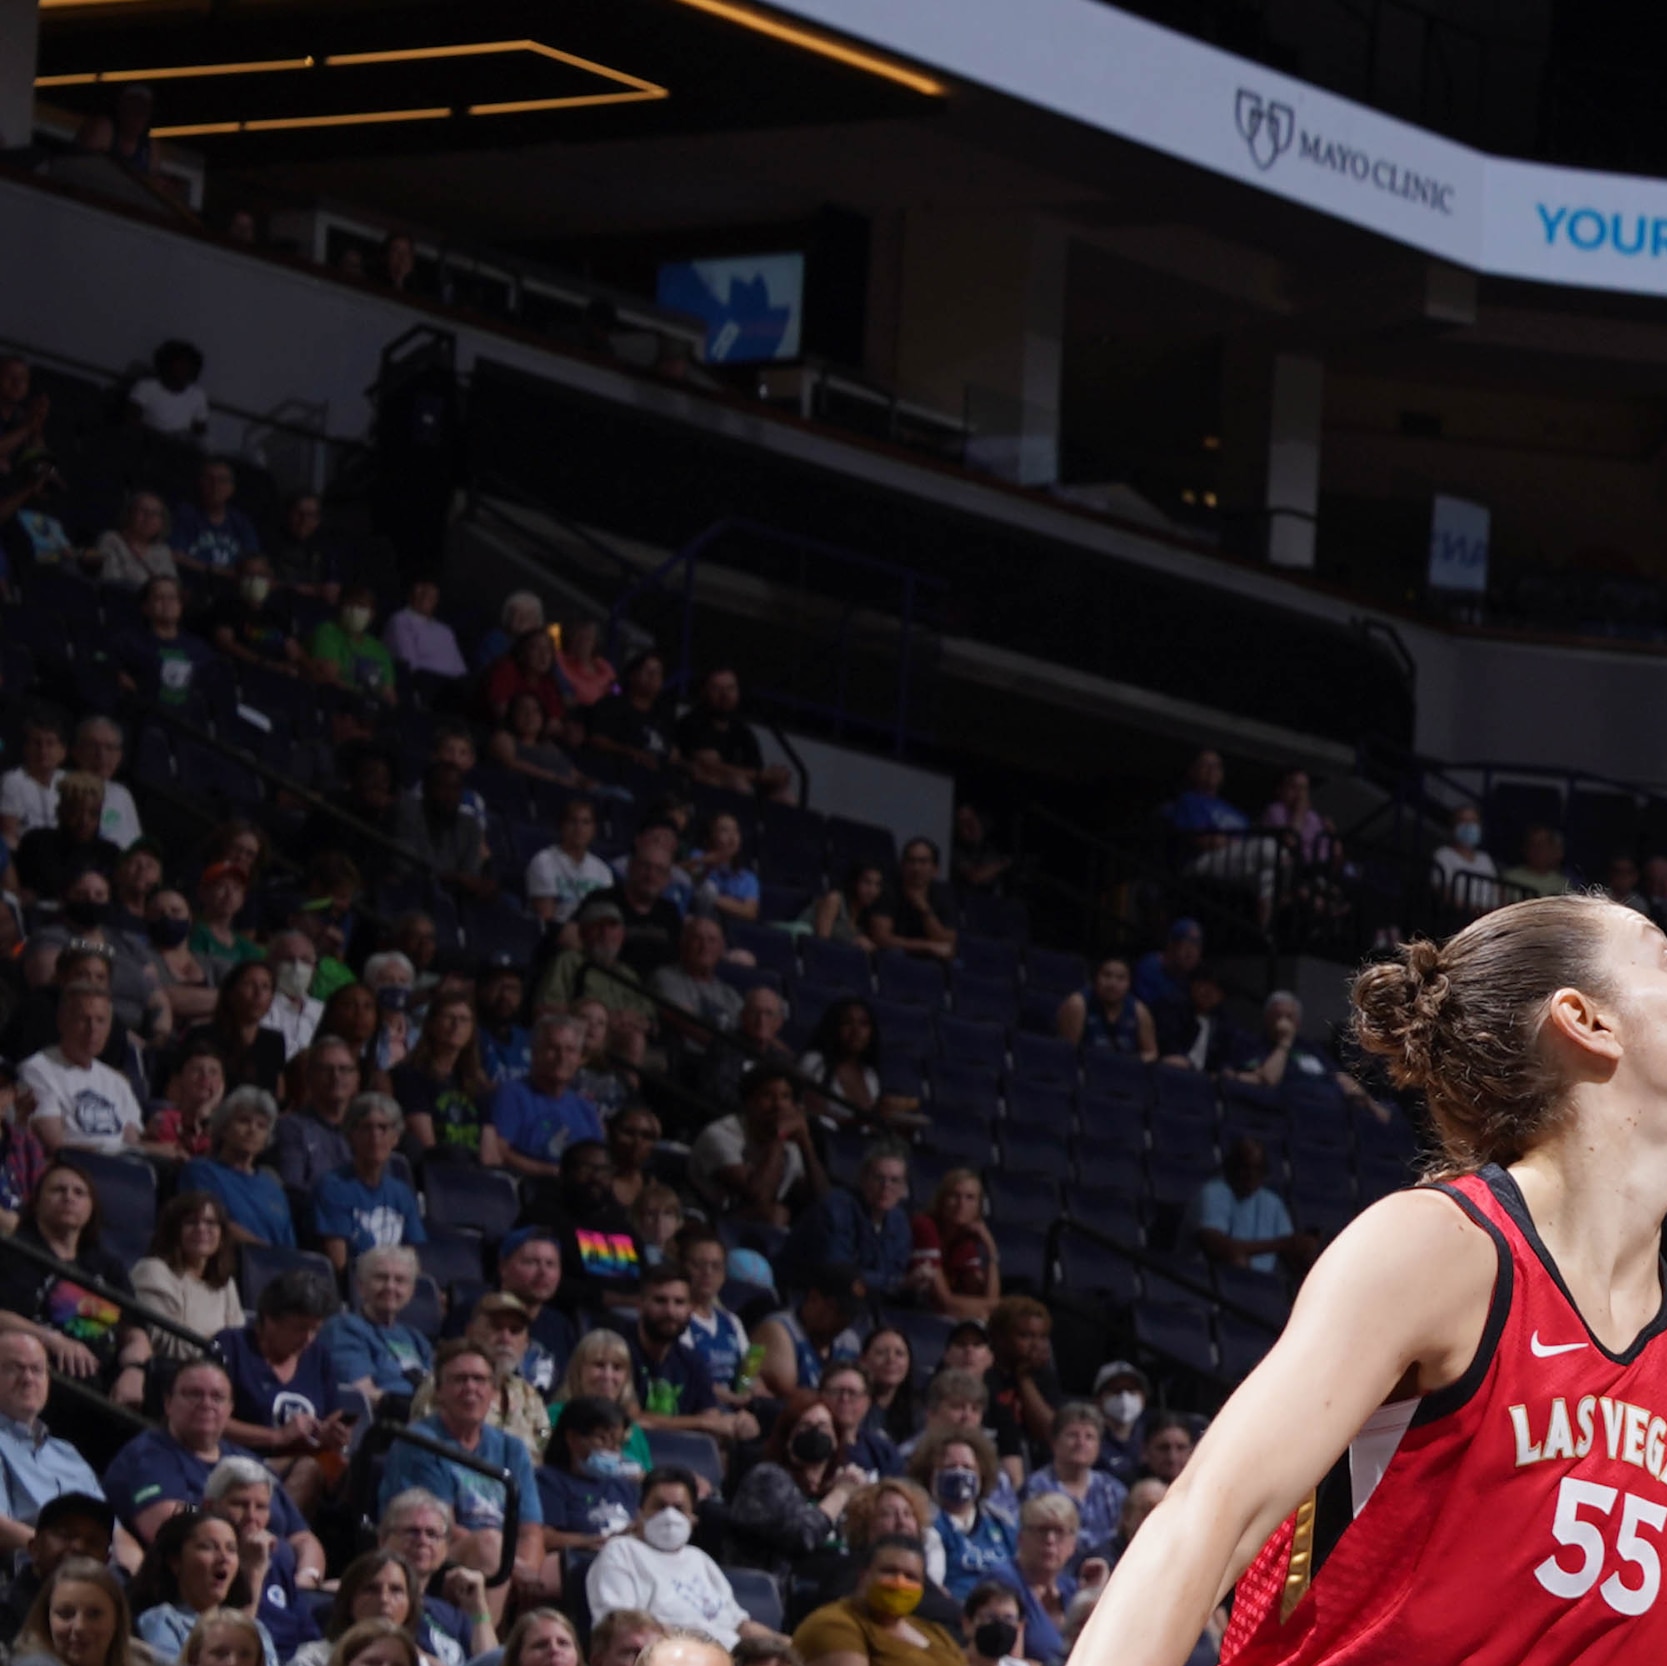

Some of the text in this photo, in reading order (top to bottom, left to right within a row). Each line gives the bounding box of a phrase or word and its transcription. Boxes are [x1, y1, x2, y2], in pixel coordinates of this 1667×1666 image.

[1299, 129, 1454, 216] MAYO CLINIC
[1507, 1393, 1595, 1468] LAS
